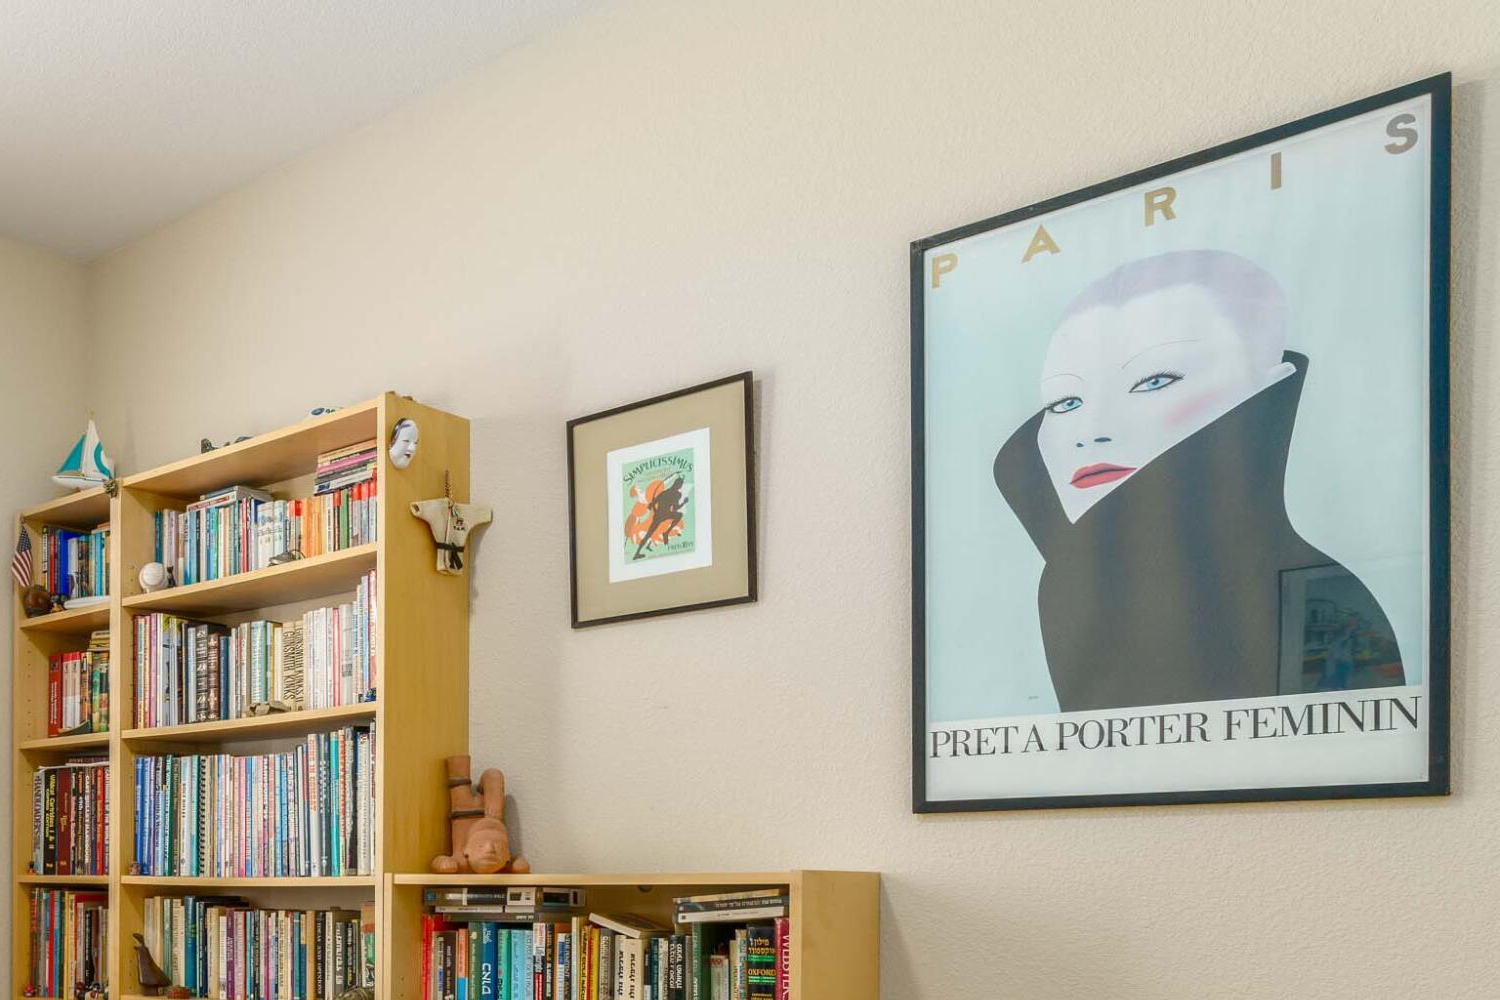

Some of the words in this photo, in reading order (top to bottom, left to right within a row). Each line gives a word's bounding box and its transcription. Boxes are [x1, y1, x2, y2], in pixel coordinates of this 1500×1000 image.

[932, 113, 1418, 289] PARIS
[623, 455, 693, 483] SIMPLICISSIMUS
[284, 630, 296, 671] GUNSMITH
[294, 628, 303, 669] GUNSMITH
[284, 674, 296, 701] KINKS
[295, 670, 303, 696] KINKS
[929, 726, 1019, 758] PRET
[1022, 724, 1045, 753] A
[1056, 711, 1212, 751] PORTER
[1223, 696, 1423, 741] FEMININ
[481, 962, 492, 995] כאוס
[748, 968, 776, 976] OXFORD
